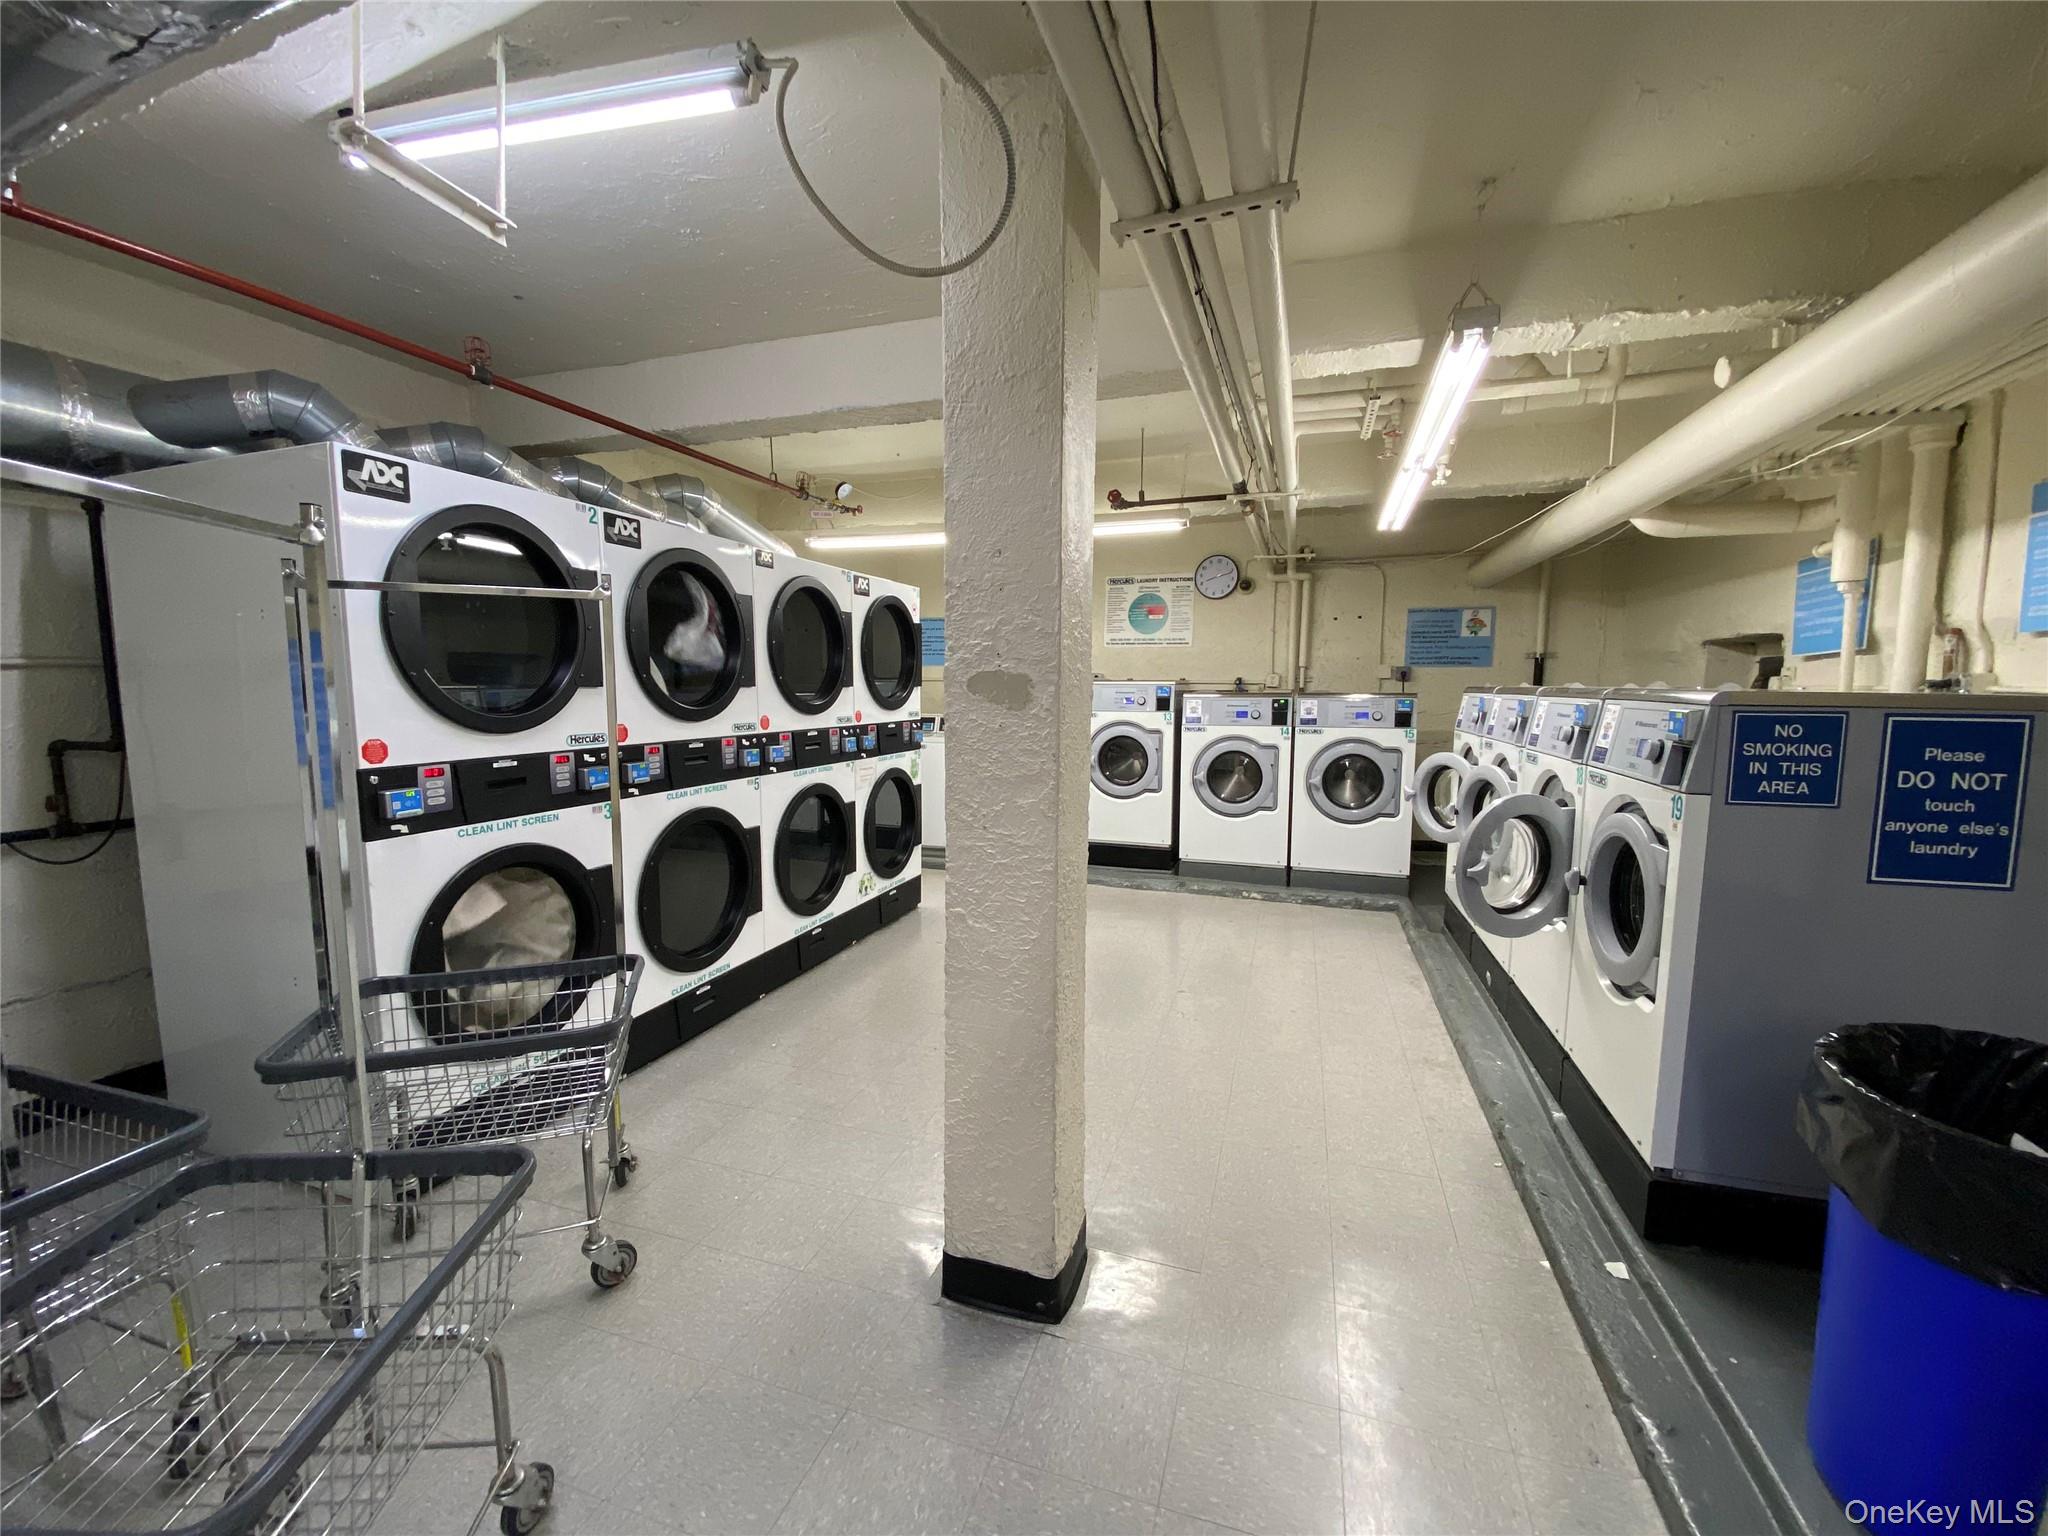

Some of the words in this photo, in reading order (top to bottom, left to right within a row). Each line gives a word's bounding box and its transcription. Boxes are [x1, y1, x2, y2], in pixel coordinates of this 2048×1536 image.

[360, 458, 405, 489] ADC
[588, 506, 598, 524] 2
[614, 517, 639, 539] ADC
[1163, 712, 1172, 721] 13
[1280, 727, 1290, 736] 14
[1403, 729, 1415, 739] 15
[1774, 724, 1803, 738] NO
[570, 734, 605, 745] Hercules
[1743, 742, 1833, 757] SMOKING
[1924, 747, 1986, 762] Please
[1576, 766, 1584, 785] 18
[1749, 761, 1768, 775] IN
[1778, 762, 1822, 776] THIS
[754, 777, 760, 791] 5
[1757, 780, 1810, 795] AREA
[1897, 770, 1936, 789] DO
[1951, 772, 2008, 791] NOT
[666, 790, 688, 801] CLEAN
[689, 787, 702, 797] LINT
[704, 783, 728, 794] SCREEN
[604, 803, 612, 820] 3
[1671, 794, 1683, 821] 19
[1924, 798, 1976, 813] touch
[457, 825, 494, 838] CLEAN
[497, 819, 519, 831] LINT
[521, 813, 560, 827] SCREEN
[1884, 821, 1949, 835] anyone
[1958, 822, 2010, 836] else's
[1909, 840, 1979, 859] laundry
[671, 981, 692, 997] CLEAN
[693, 974, 706, 986] LINT
